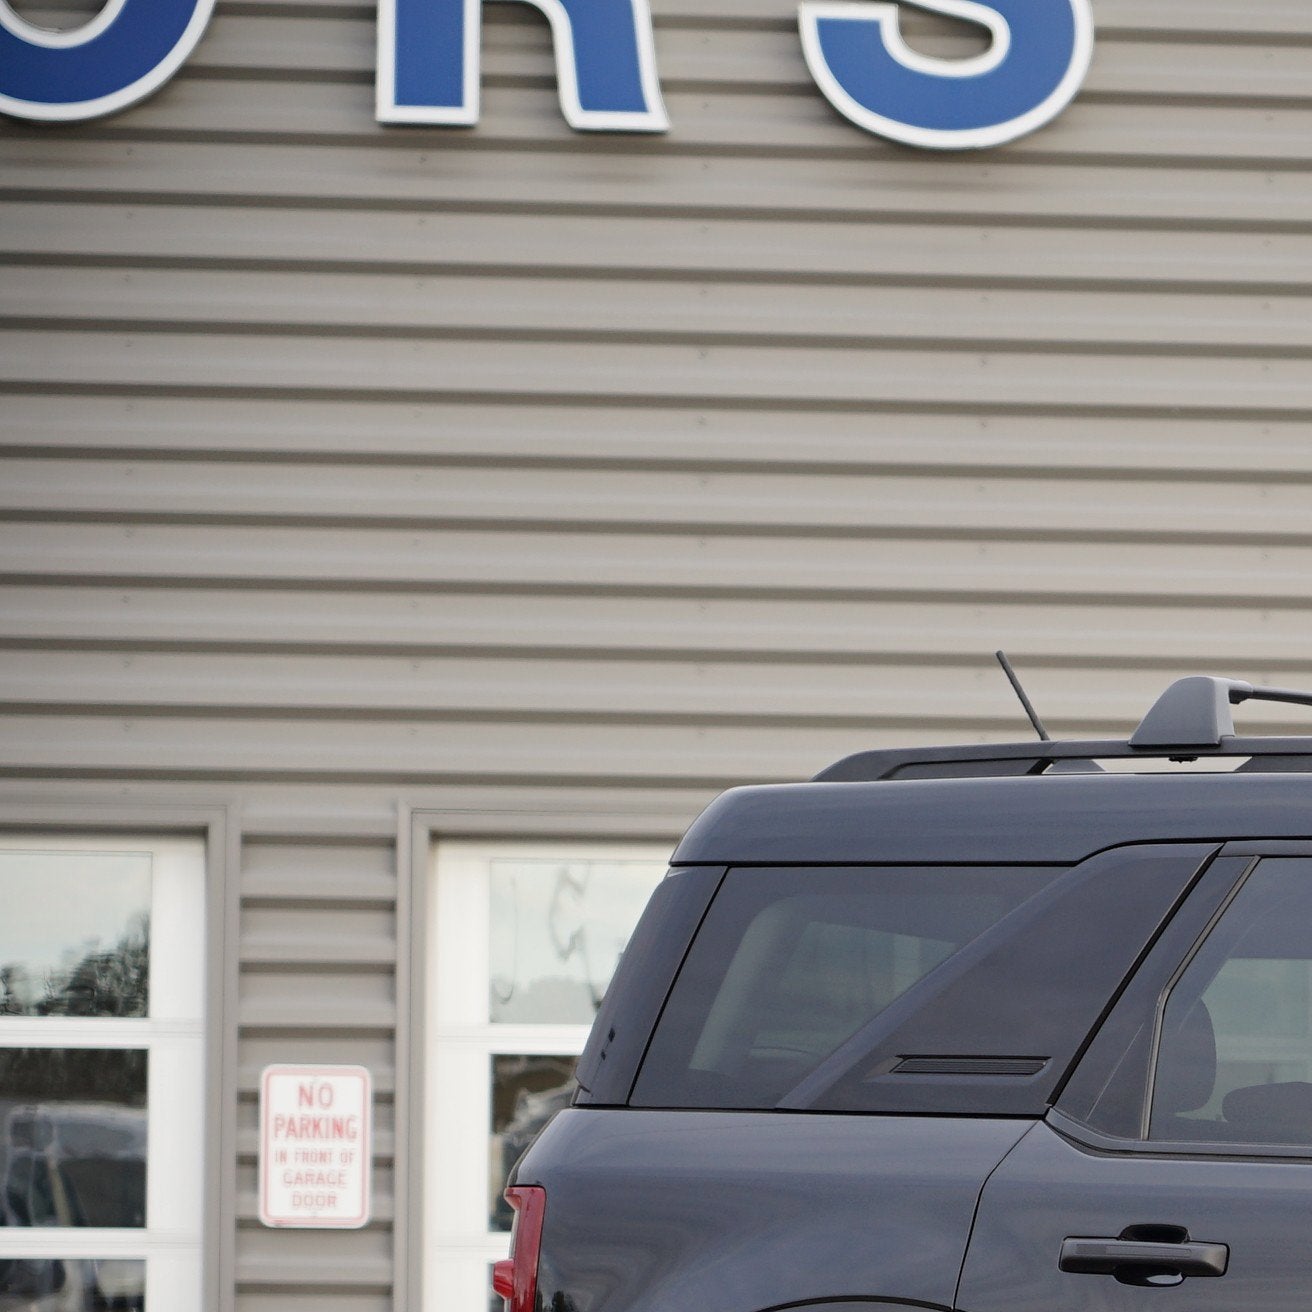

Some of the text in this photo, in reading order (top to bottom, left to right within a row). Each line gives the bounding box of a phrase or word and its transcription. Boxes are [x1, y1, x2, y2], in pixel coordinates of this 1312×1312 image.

[298, 1083, 334, 1110] NO
[273, 1116, 358, 1141] PARKING
[275, 1149, 355, 1165] IN FRONT OF
[283, 1170, 348, 1187] GARAGE
[292, 1192, 338, 1209] DOOR
